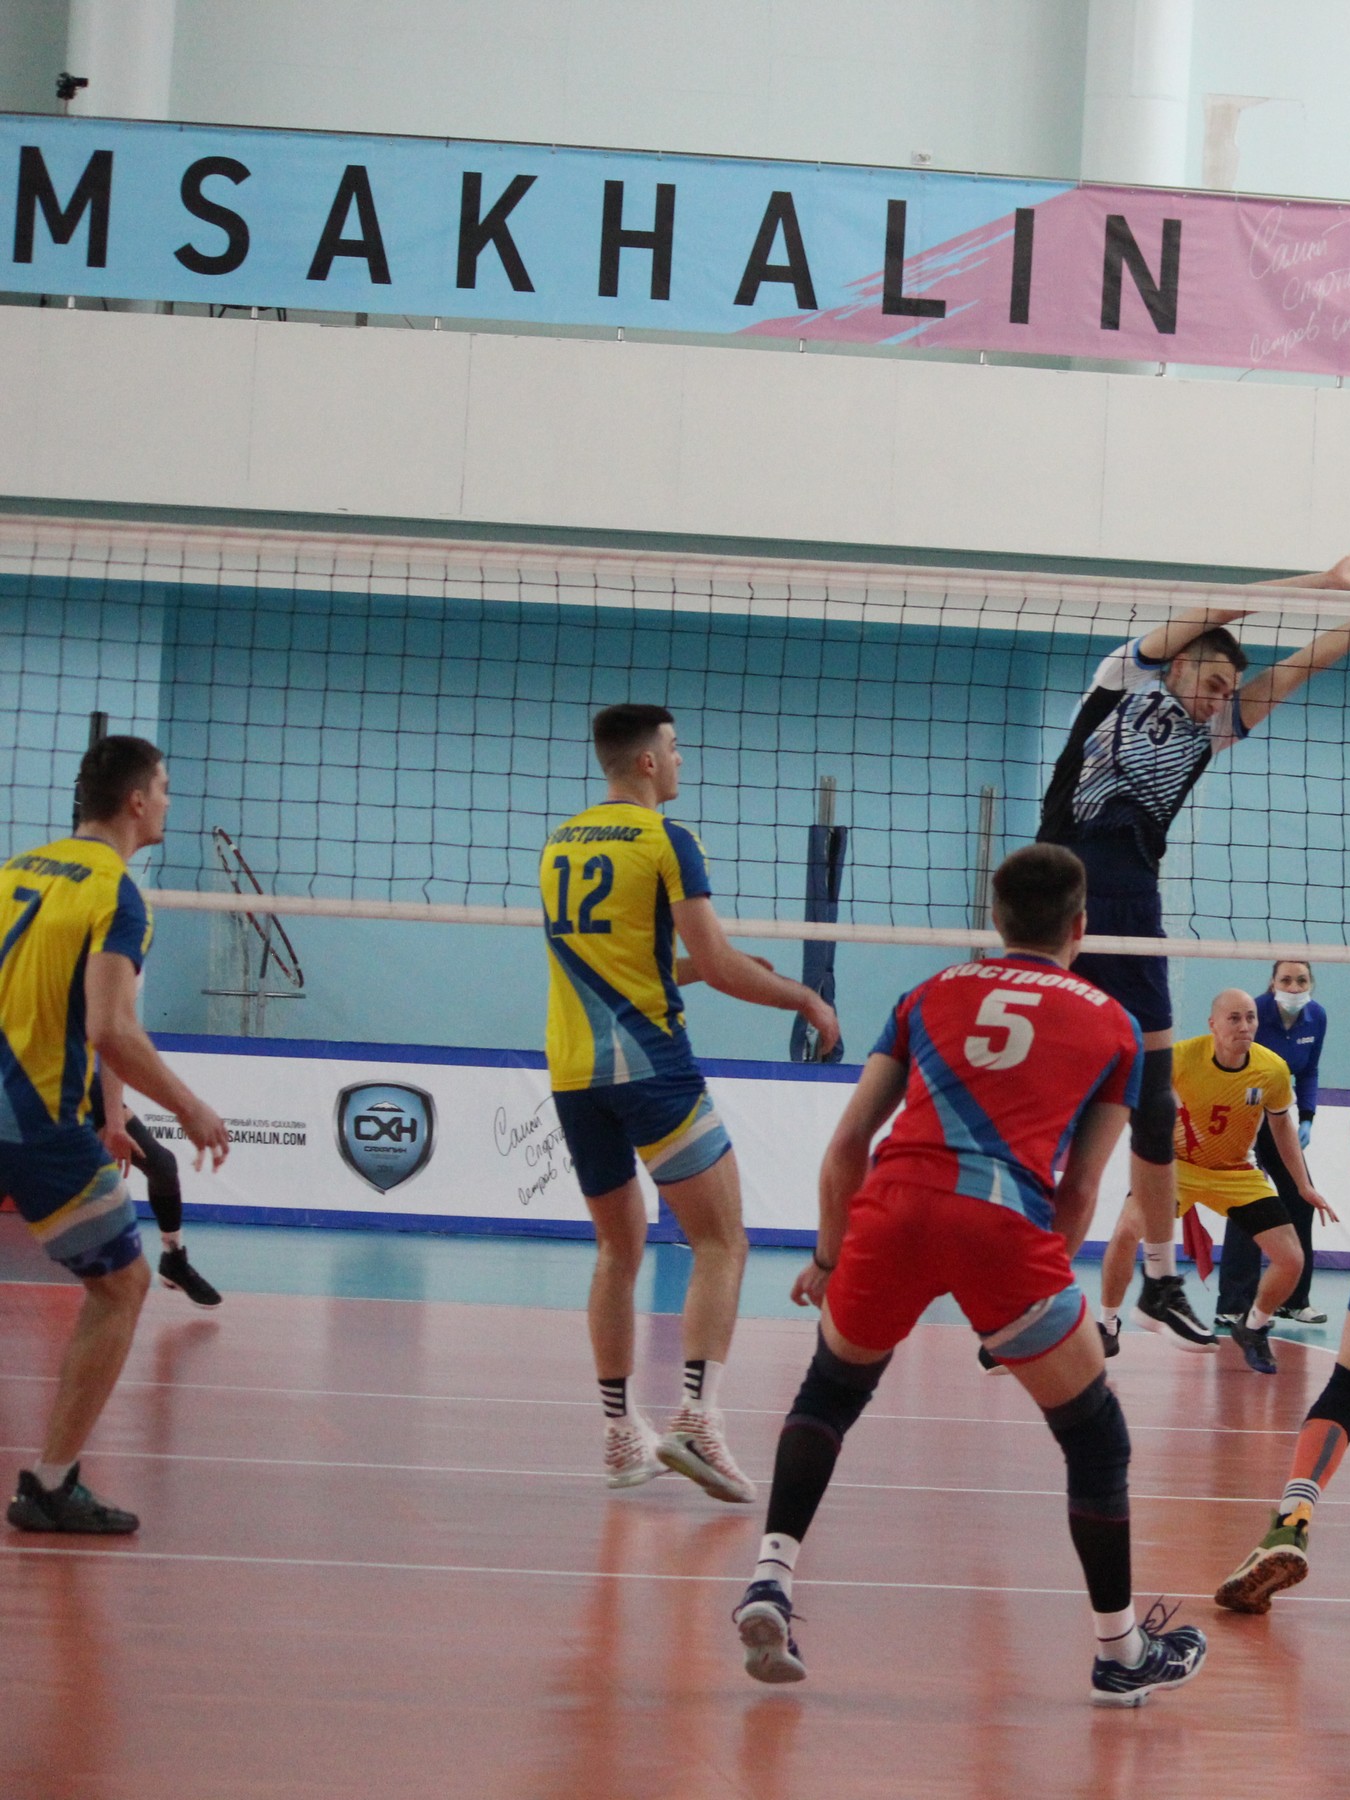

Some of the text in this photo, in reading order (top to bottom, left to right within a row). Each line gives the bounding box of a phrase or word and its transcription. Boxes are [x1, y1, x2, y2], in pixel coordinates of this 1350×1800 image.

[1133, 691, 1185, 746] 15
[0, 886, 42, 969] 7
[551, 854, 614, 935] 12
[964, 988, 1043, 1070] 5
[1208, 1105, 1232, 1135] 5
